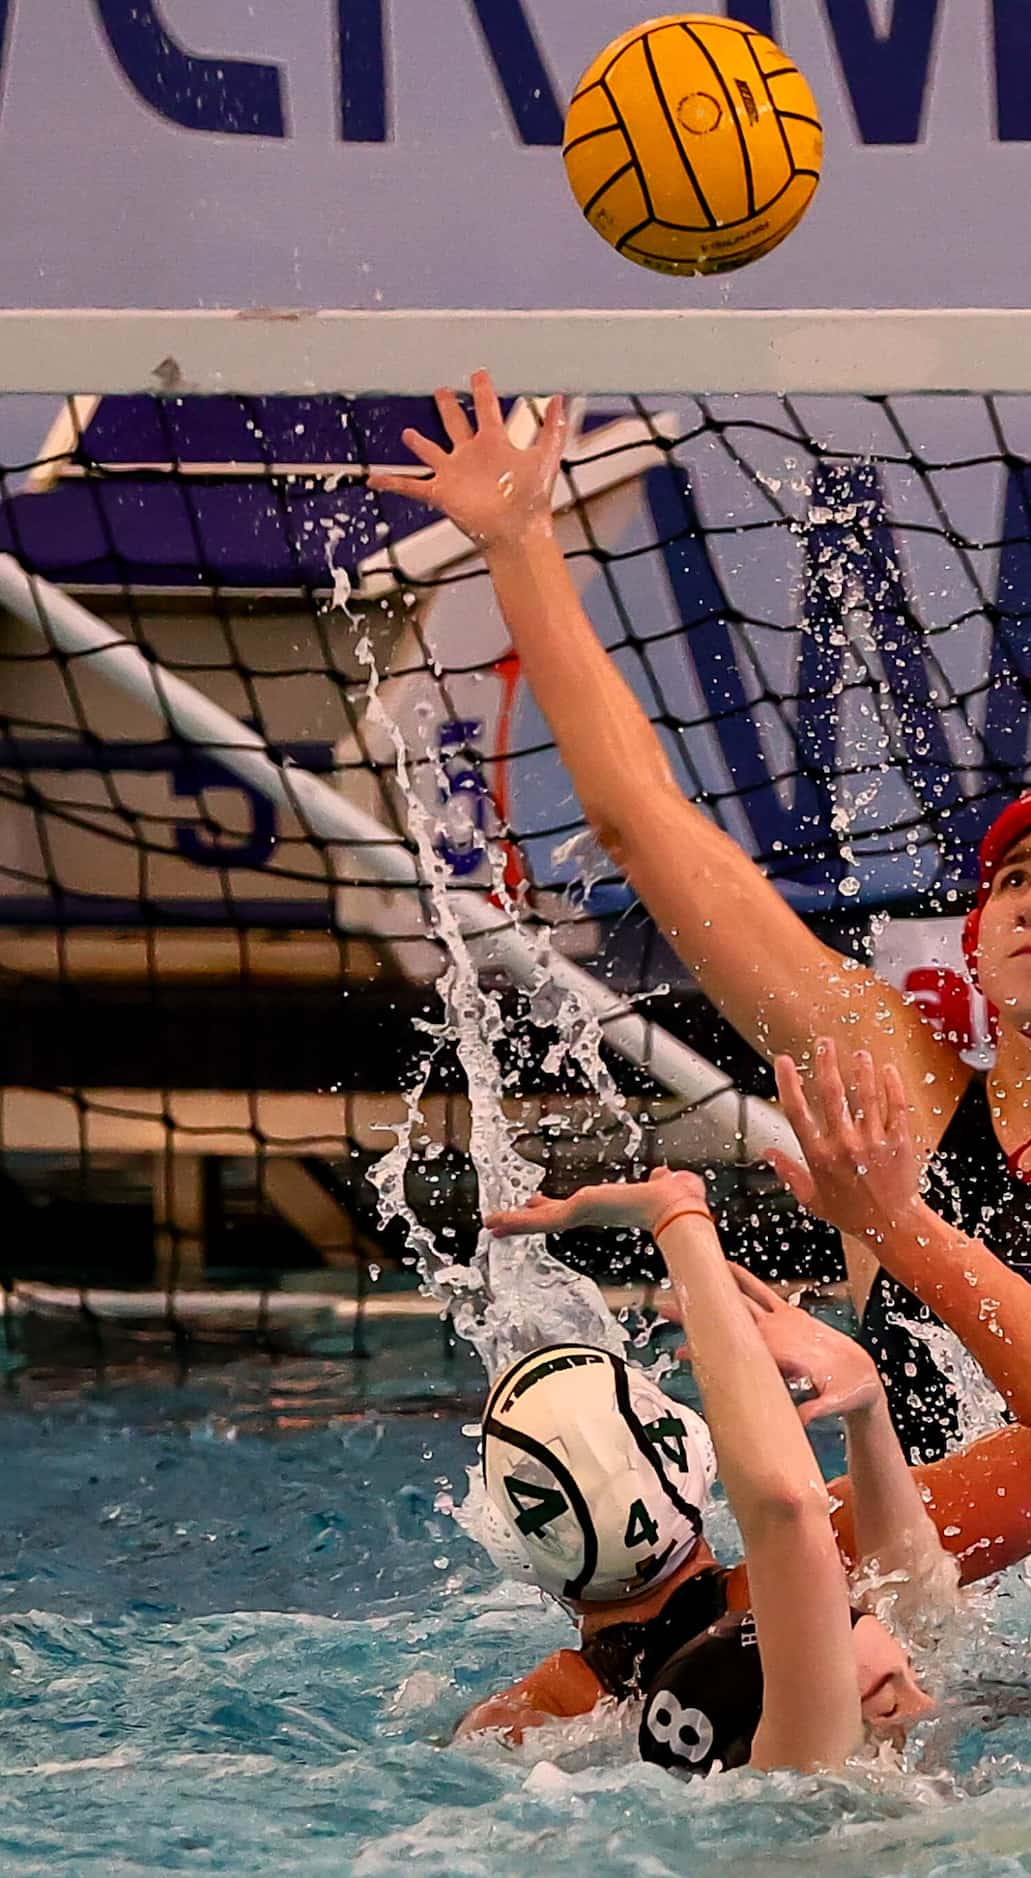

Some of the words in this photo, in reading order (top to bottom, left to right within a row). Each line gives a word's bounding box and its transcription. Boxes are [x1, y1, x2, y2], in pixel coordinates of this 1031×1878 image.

[644, 1410, 689, 1473] 4
[503, 1475, 569, 1539] 4
[624, 1498, 658, 1548] 4
[647, 1690, 714, 1763] 8
